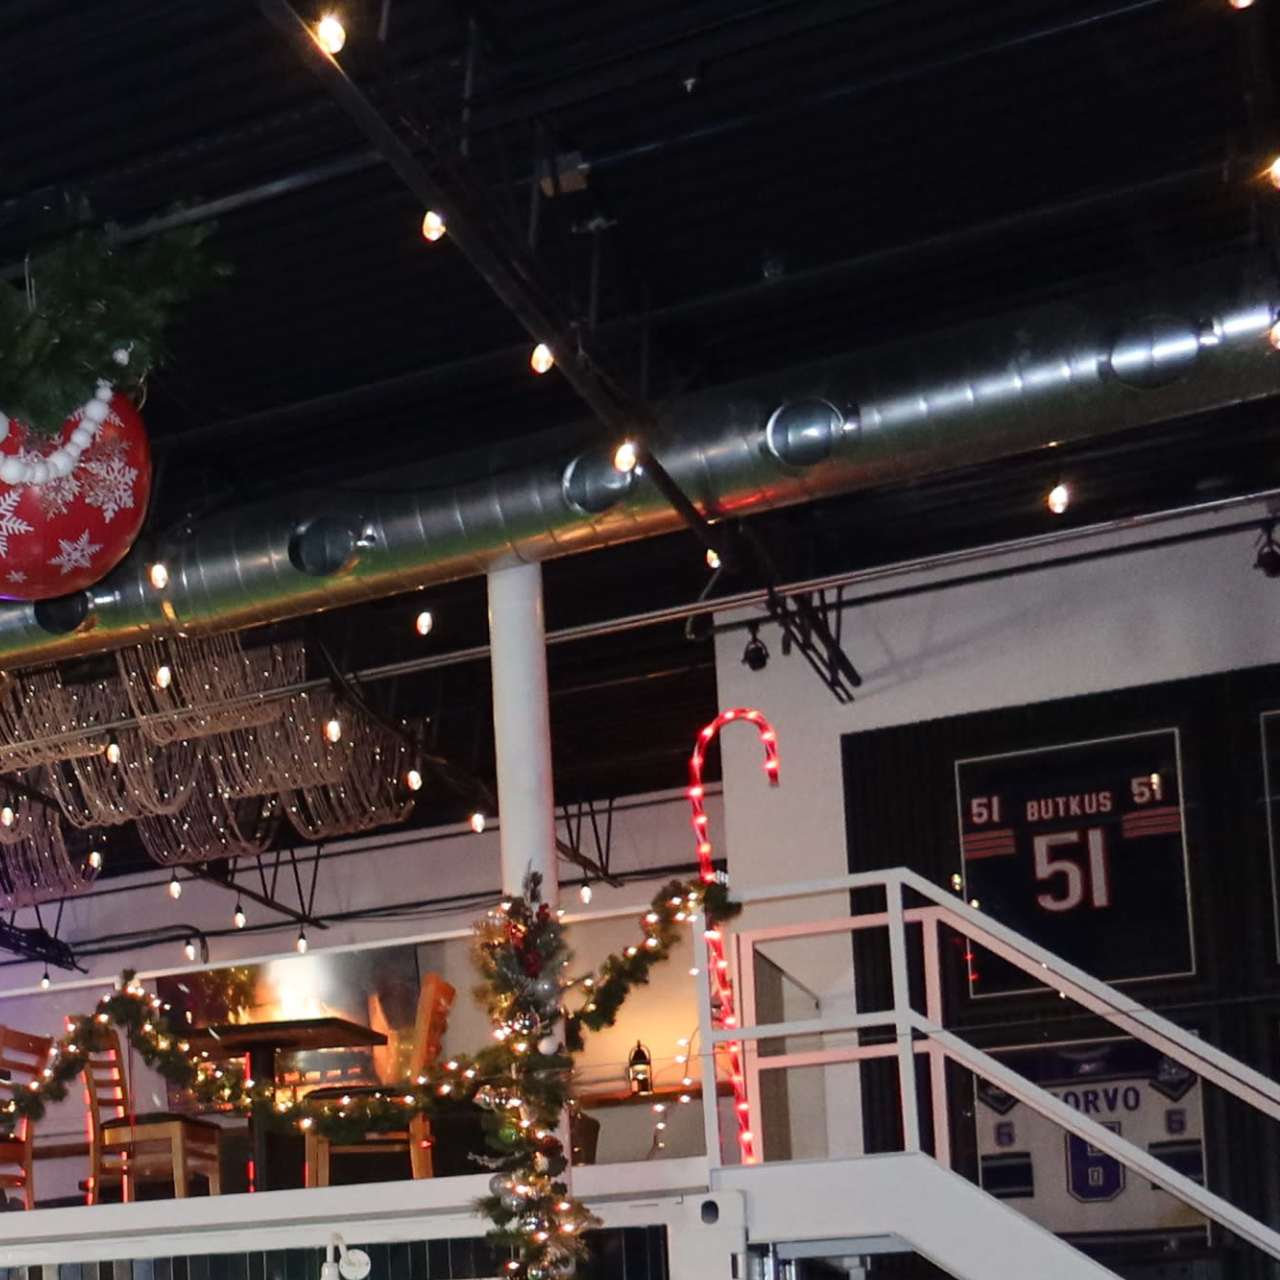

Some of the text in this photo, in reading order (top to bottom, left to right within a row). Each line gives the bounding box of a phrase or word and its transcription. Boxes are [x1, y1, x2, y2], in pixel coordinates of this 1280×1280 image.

[971, 796, 1001, 824] 51
[1026, 791, 1113, 822] BUTKUS
[1033, 827, 1109, 912] 51
[1051, 1086, 1140, 1113] ORVO
